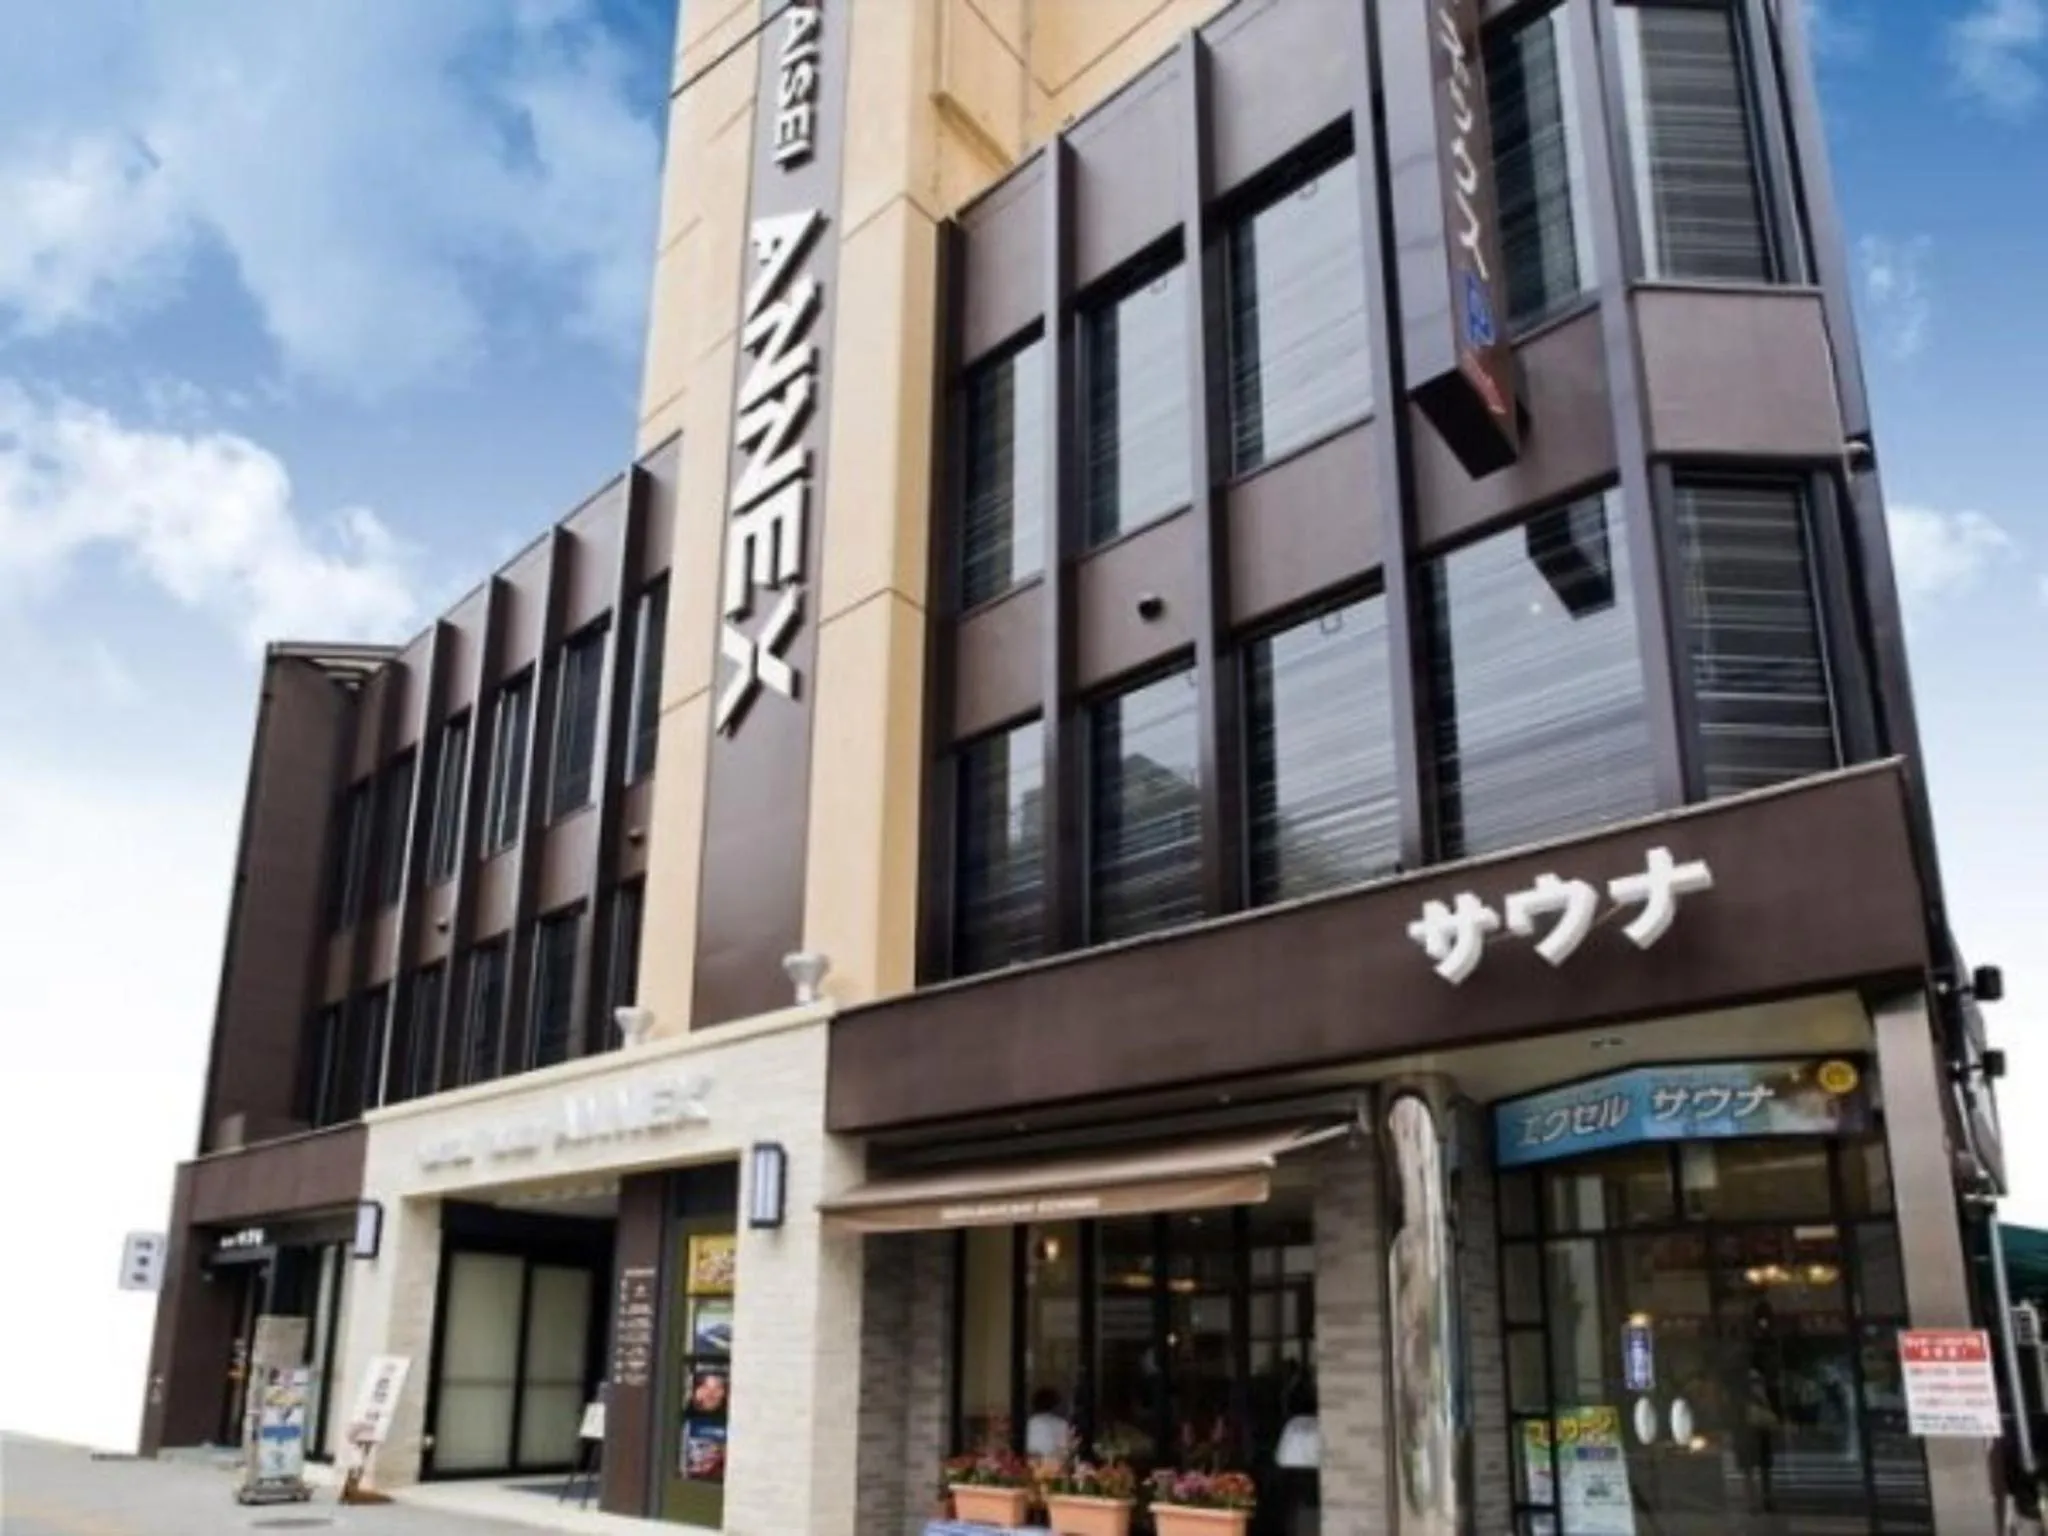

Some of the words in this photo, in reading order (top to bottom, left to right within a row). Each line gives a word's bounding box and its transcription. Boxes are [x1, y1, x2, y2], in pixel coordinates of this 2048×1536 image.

[772, 0, 820, 168] AISEI
[717, 209, 823, 736] ANNEX
[1407, 846, 1713, 985] サウナ
[1519, 1094, 1629, 1145] エクセル
[1652, 1082, 1776, 1122] サウナ
